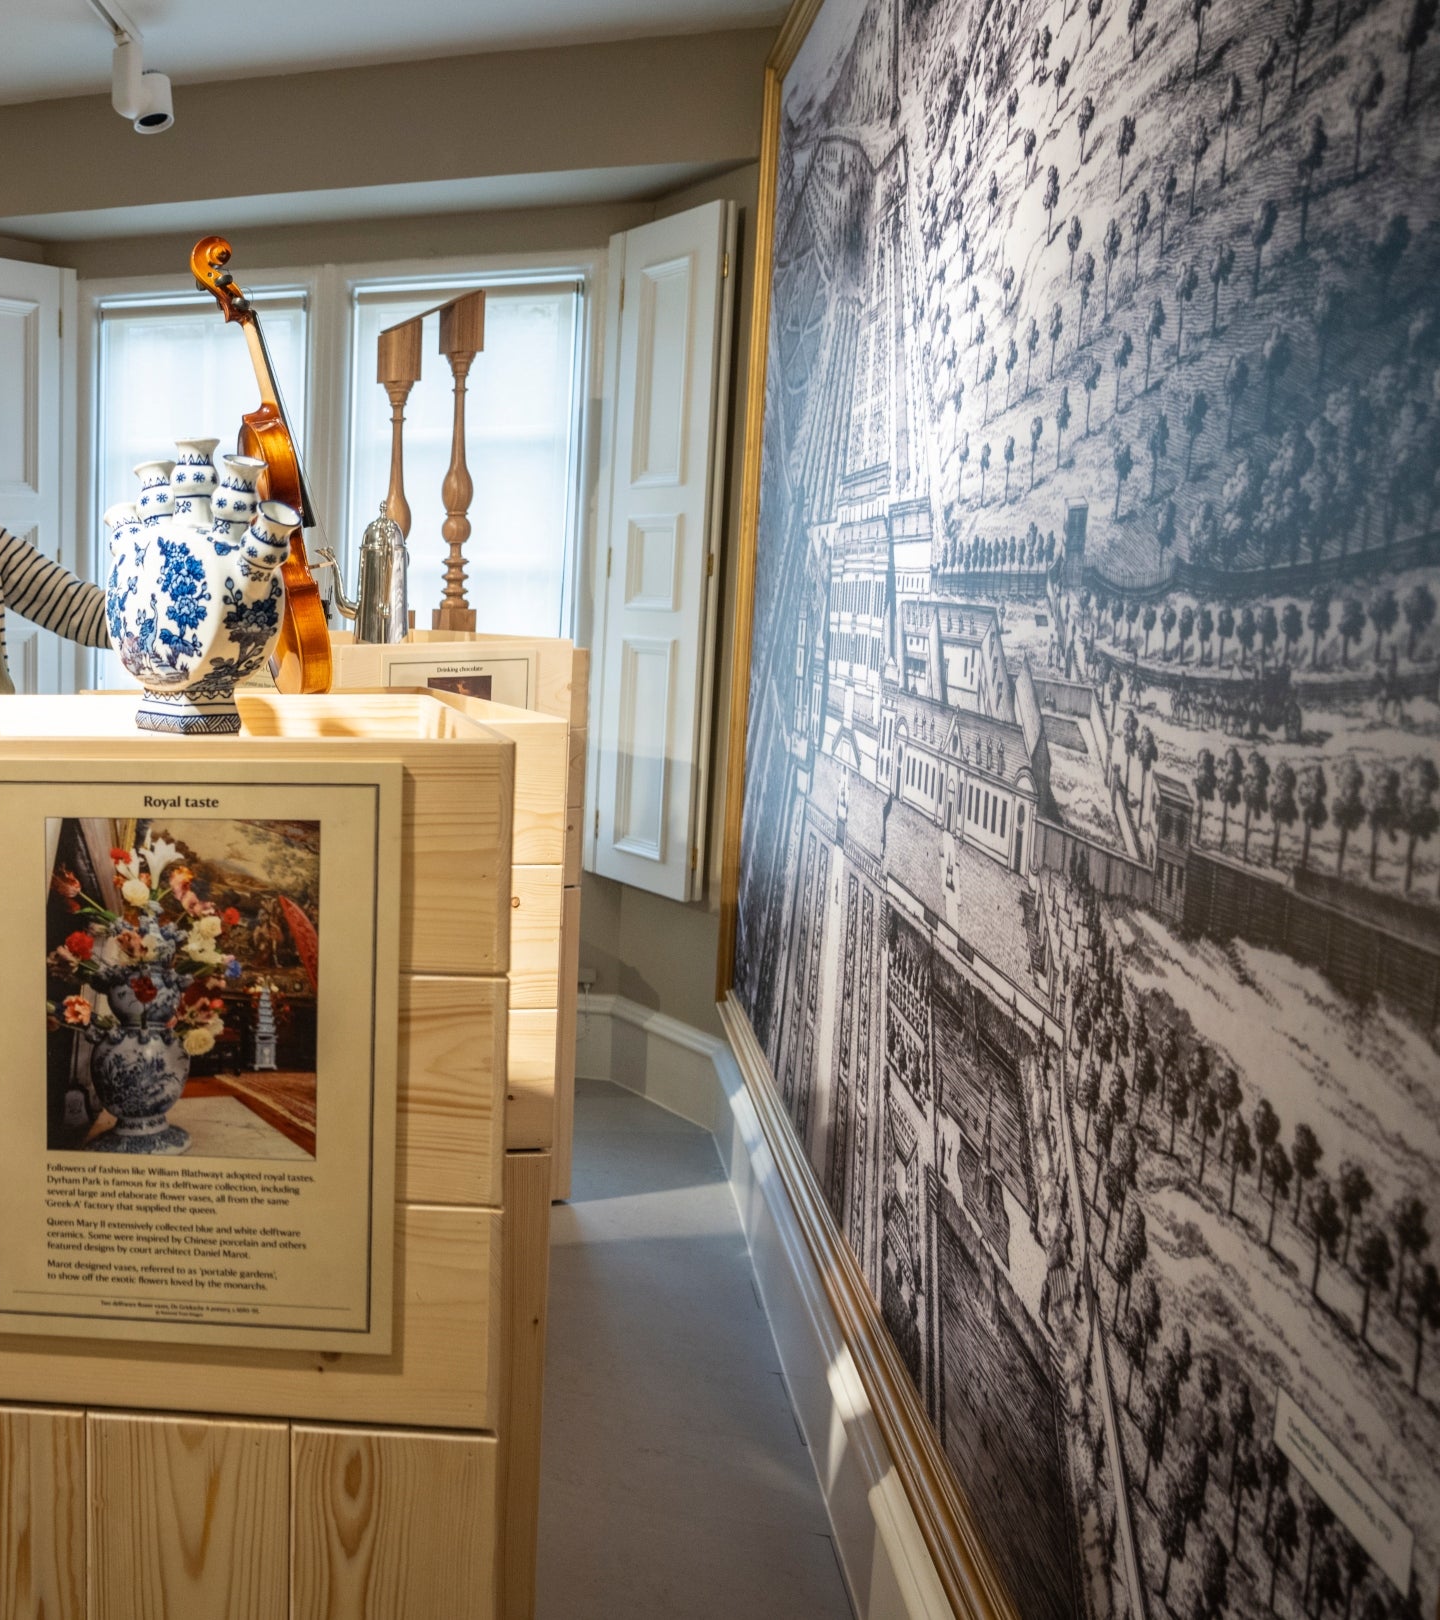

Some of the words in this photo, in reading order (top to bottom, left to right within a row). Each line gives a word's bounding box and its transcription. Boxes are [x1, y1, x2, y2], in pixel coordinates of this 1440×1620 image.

[436, 666, 459, 674] Drinking
[459, 664, 484, 673] chocolate
[143, 795, 181, 810] Royal
[184, 797, 220, 808] taste
[47, 1163, 85, 1173] Followers
[88, 1164, 97, 1173] of
[98, 1165, 130, 1175] fashion
[132, 1166, 145, 1175] like
[148, 1167, 179, 1177] William
[181, 1169, 223, 1180] Blathwayt
[226, 1171, 261, 1181] adopted
[263, 1173, 285, 1182] royal
[47, 1175, 80, 1185] Dyrham
[82, 1176, 101, 1186] Park
[103, 1178, 110, 1186] is
[112, 1178, 143, 1188] famous
[145, 1179, 157, 1188] for
[160, 1180, 170, 1188] its
[172, 1181, 212, 1190] delftware
[215, 1183, 259, 1193] collection,
[261, 1185, 300, 1196] including
[47, 1188, 75, 1197] several
[77, 1189, 98, 1199] large
[100, 1190, 116, 1199] and
[118, 1191, 158, 1200] elaborate
[160, 1192, 185, 1201] flower
[188, 1195, 213, 1203] vases,
[216, 1195, 225, 1203] all
[228, 1195, 248, 1204] from
[250, 1196, 264, 1205] the
[84, 1201, 114, 1211] factory
[116, 1202, 133, 1211] that
[136, 1203, 170, 1213] supplied
[173, 1204, 186, 1213] the
[47, 1218, 74, 1227] Queen
[76, 1219, 99, 1229] Mary
[100, 1220, 106, 1228] II
[107, 1221, 153, 1231] extensively
[155, 1223, 193, 1232] collected
[195, 1224, 213, 1233] blue
[216, 1226, 232, 1234] and
[234, 1226, 257, 1235] white
[260, 1227, 301, 1237] delftware
[47, 1242, 82, 1251] featured
[84, 1243, 115, 1254] designs
[117, 1244, 127, 1254] by
[129, 1246, 152, 1254] court
[154, 1247, 191, 1256] architect
[193, 1248, 220, 1257] Daniel
[88, 1232, 111, 1240] Some
[136, 1234, 169, 1244] inspired
[171, 1235, 181, 1245] by
[184, 1236, 217, 1245] Chinese
[220, 1238, 259, 1248] porcelain
[261, 1240, 277, 1249] and
[279, 1241, 307, 1250] others
[47, 1259, 72, 1268] Marot
[74, 1261, 112, 1271] designed
[113, 1264, 138, 1272] vases,
[141, 1264, 174, 1274] referred
[58, 1271, 80, 1280] show
[82, 1272, 94, 1281] off
[95, 1274, 109, 1282] the
[111, 1275, 135, 1284] exotic
[138, 1276, 169, 1285] flowers
[170, 1278, 193, 1287] loved
[195, 1279, 205, 1288] by
[207, 1279, 222, 1288] the
[224, 1281, 267, 1290] monarchs.
